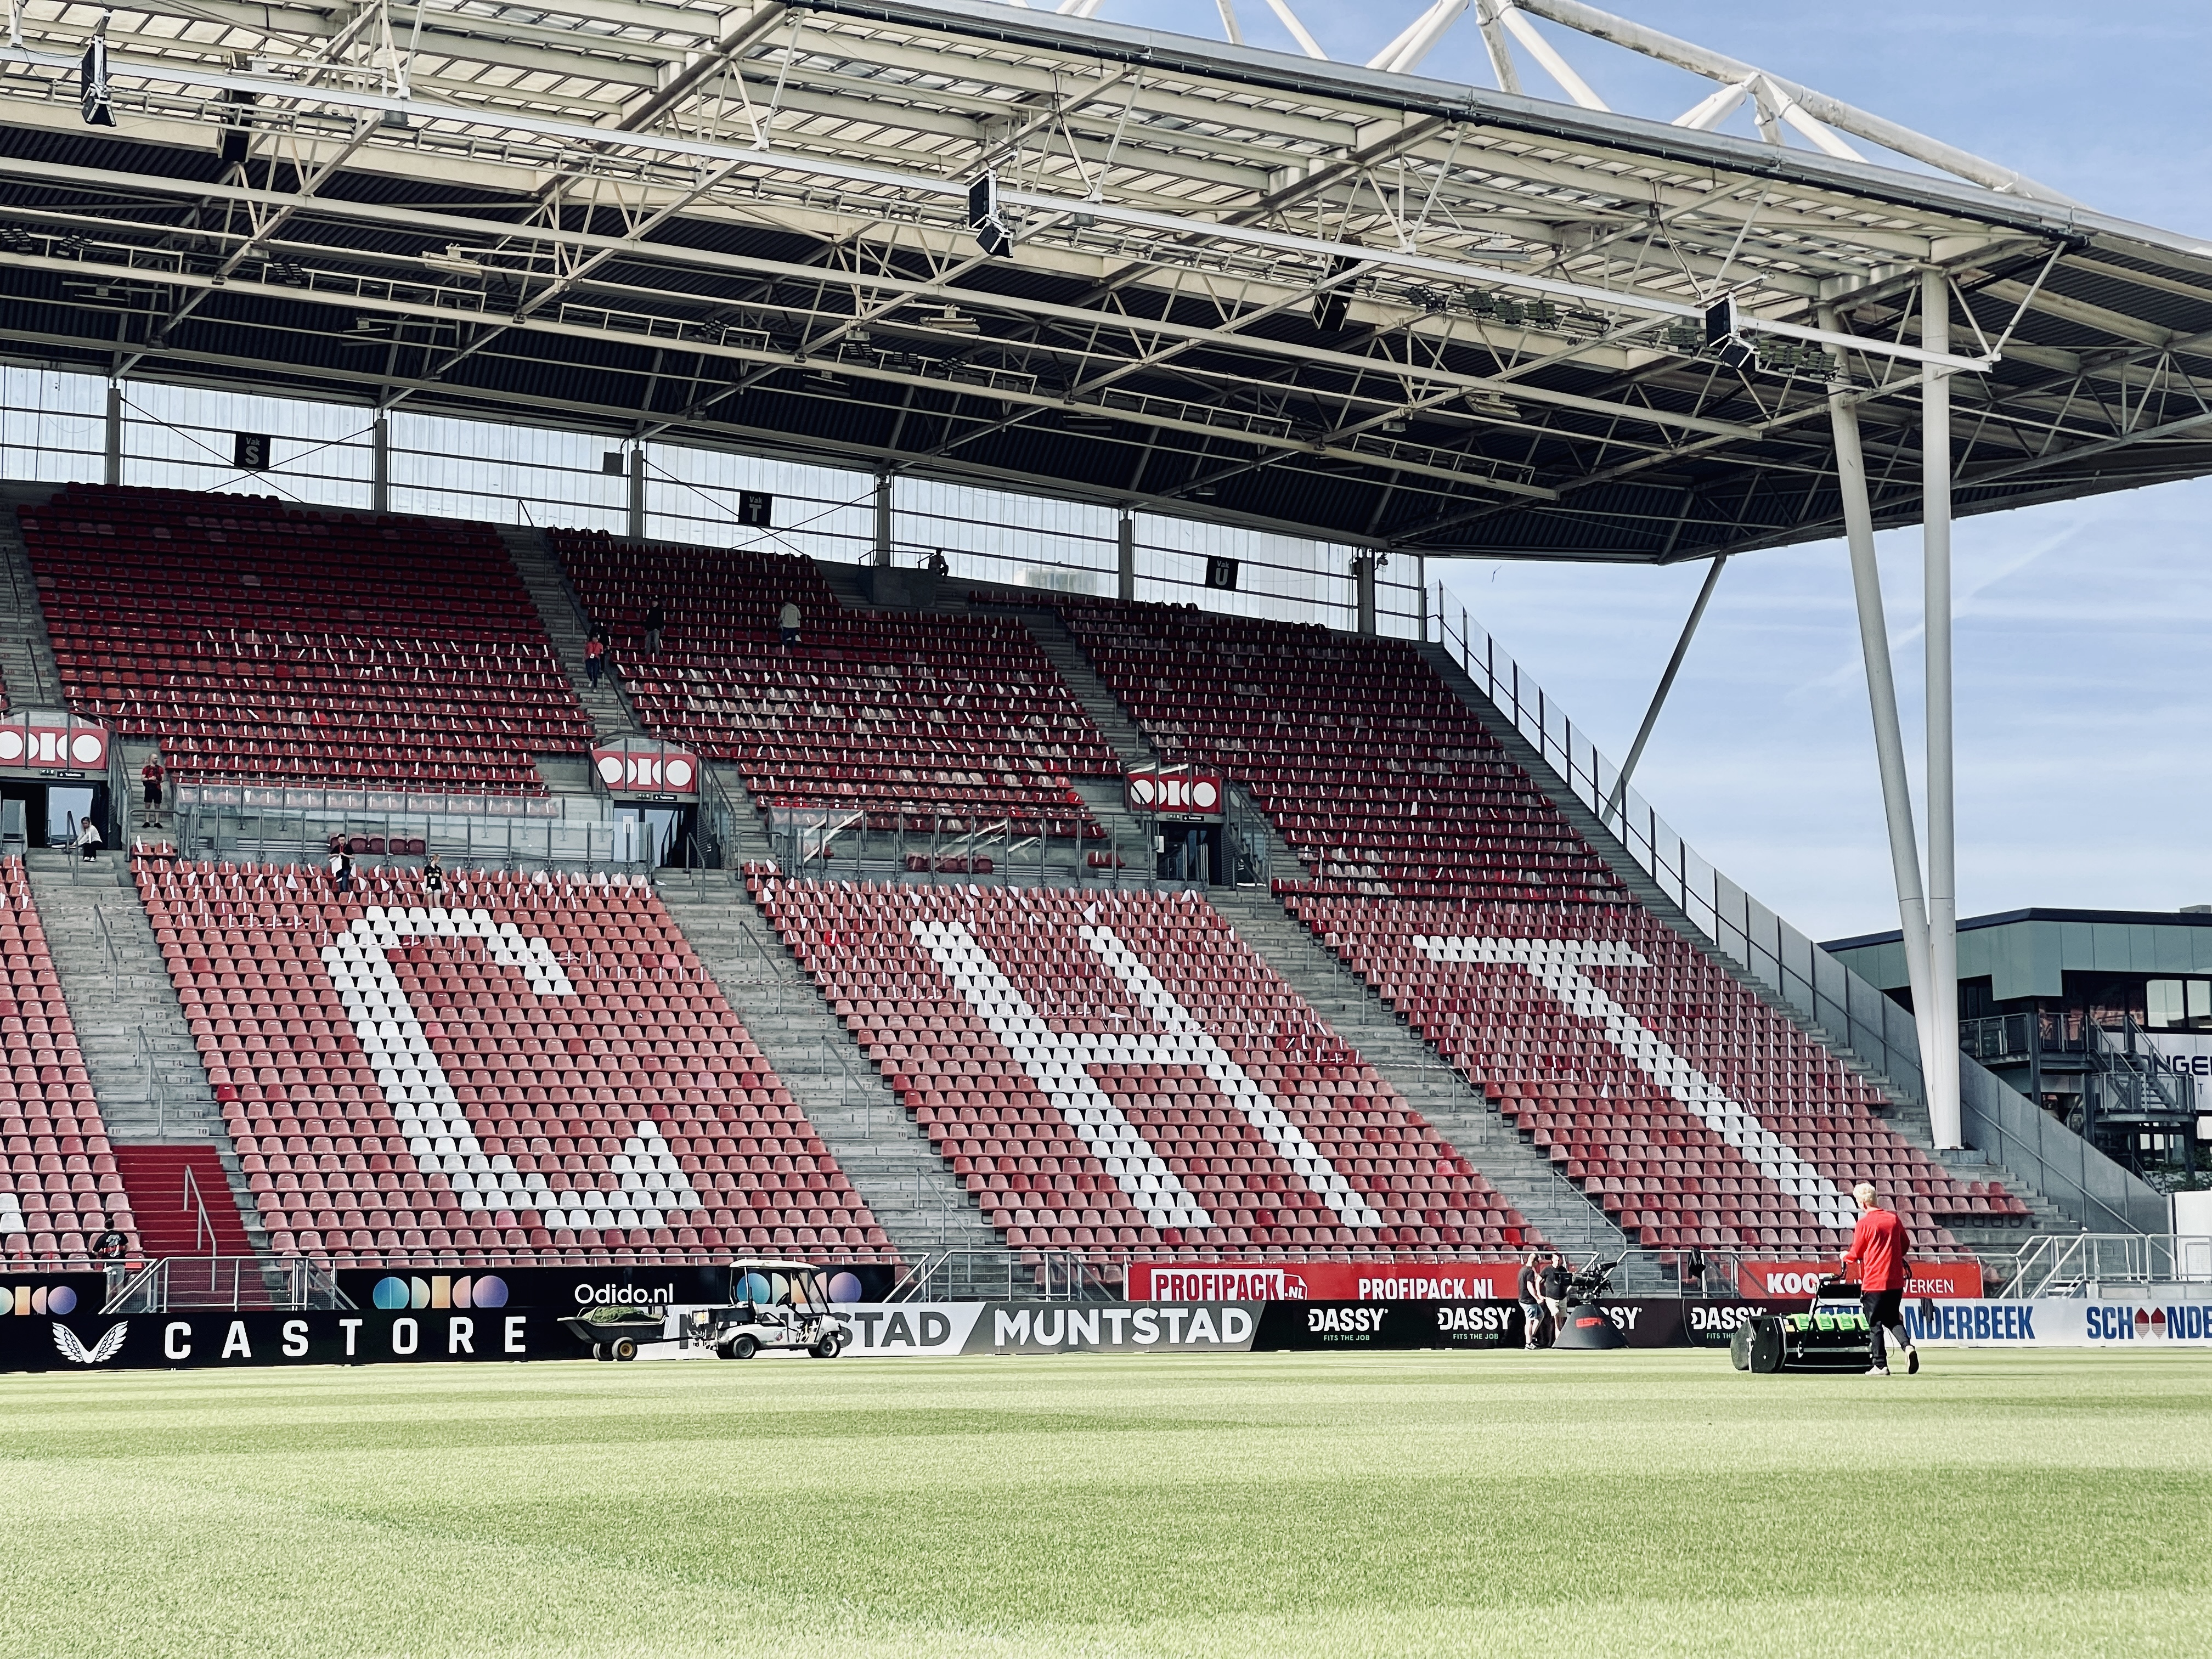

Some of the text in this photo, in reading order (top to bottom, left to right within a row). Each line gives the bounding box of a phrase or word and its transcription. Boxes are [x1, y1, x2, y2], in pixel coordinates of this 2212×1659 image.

[246, 437, 260, 445] Vak
[245, 445, 259, 465] S
[749, 496, 763, 504] Vak
[749, 504, 762, 522] T
[1217, 560, 1229, 568] Vak
[1215, 567, 1229, 586] U
[2138, 1053, 2212, 1076] NGE
[574, 1283, 674, 1304] Odido.nl
[1358, 1278, 1498, 1299] PROFIPACK.NL
[995, 1307, 1254, 1347] MUNTSTAD
[165, 1317, 527, 1359] CASTORE
